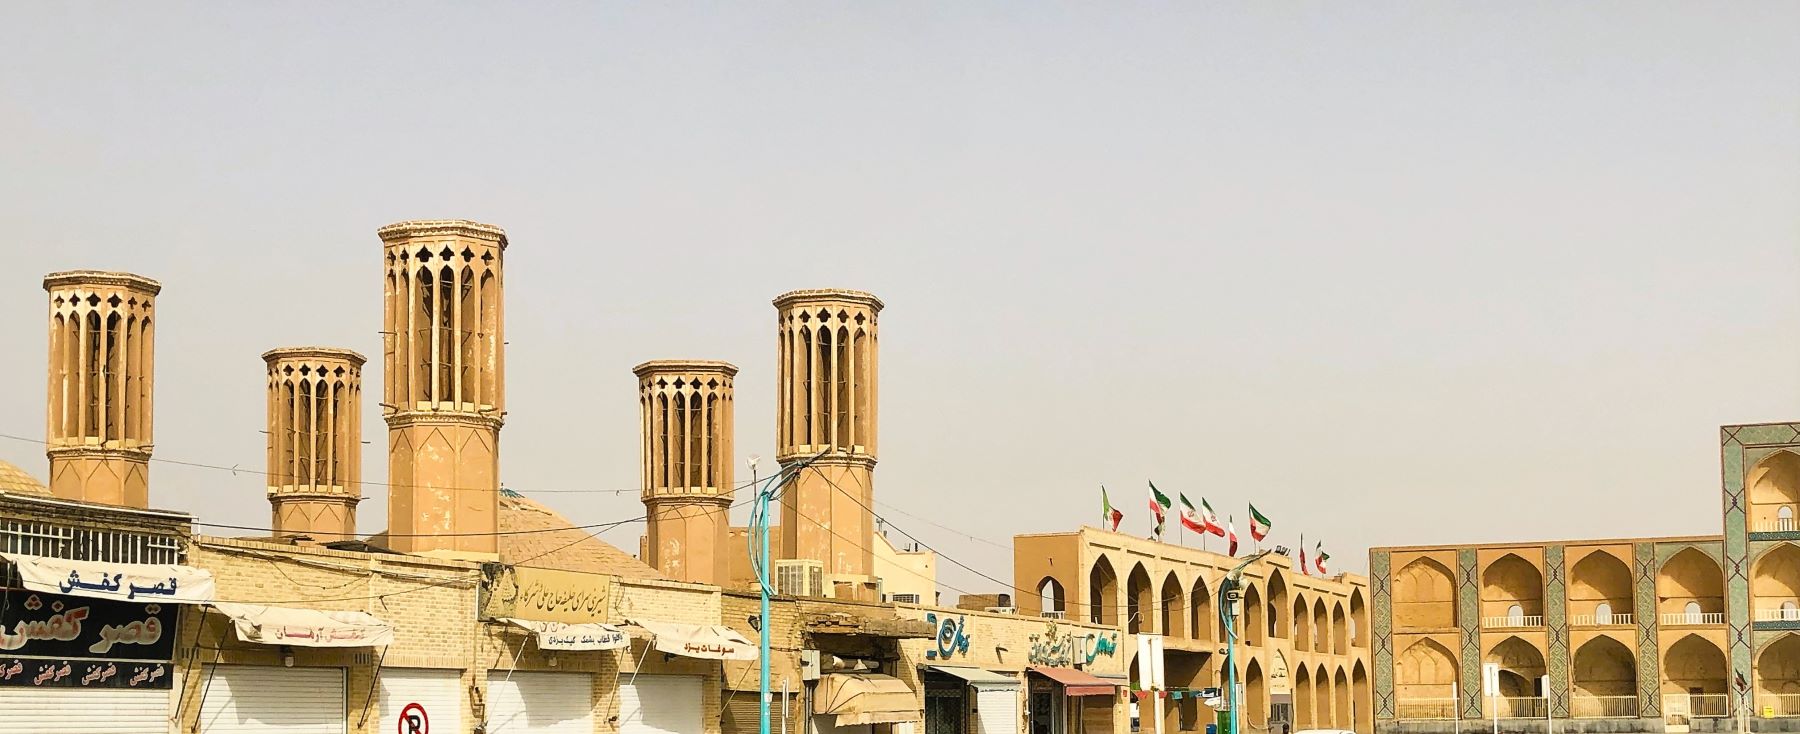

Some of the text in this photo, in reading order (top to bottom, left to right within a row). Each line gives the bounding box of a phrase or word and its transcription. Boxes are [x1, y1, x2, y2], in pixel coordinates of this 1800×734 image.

[59, 569, 178, 599] قصر کفش
[547, 589, 562, 611] حاج
[560, 584, 575, 612] خلیفه
[572, 589, 591, 611] سرای
[587, 585, 606, 616] شیرینی
[0, 594, 162, 654] قصر کفش
[684, 642, 735, 656] سوغات یزد
[34, 660, 71, 686] قصر کفش
[81, 661, 117, 686] قصر کفش
[129, 663, 165, 687] قصر کفش
